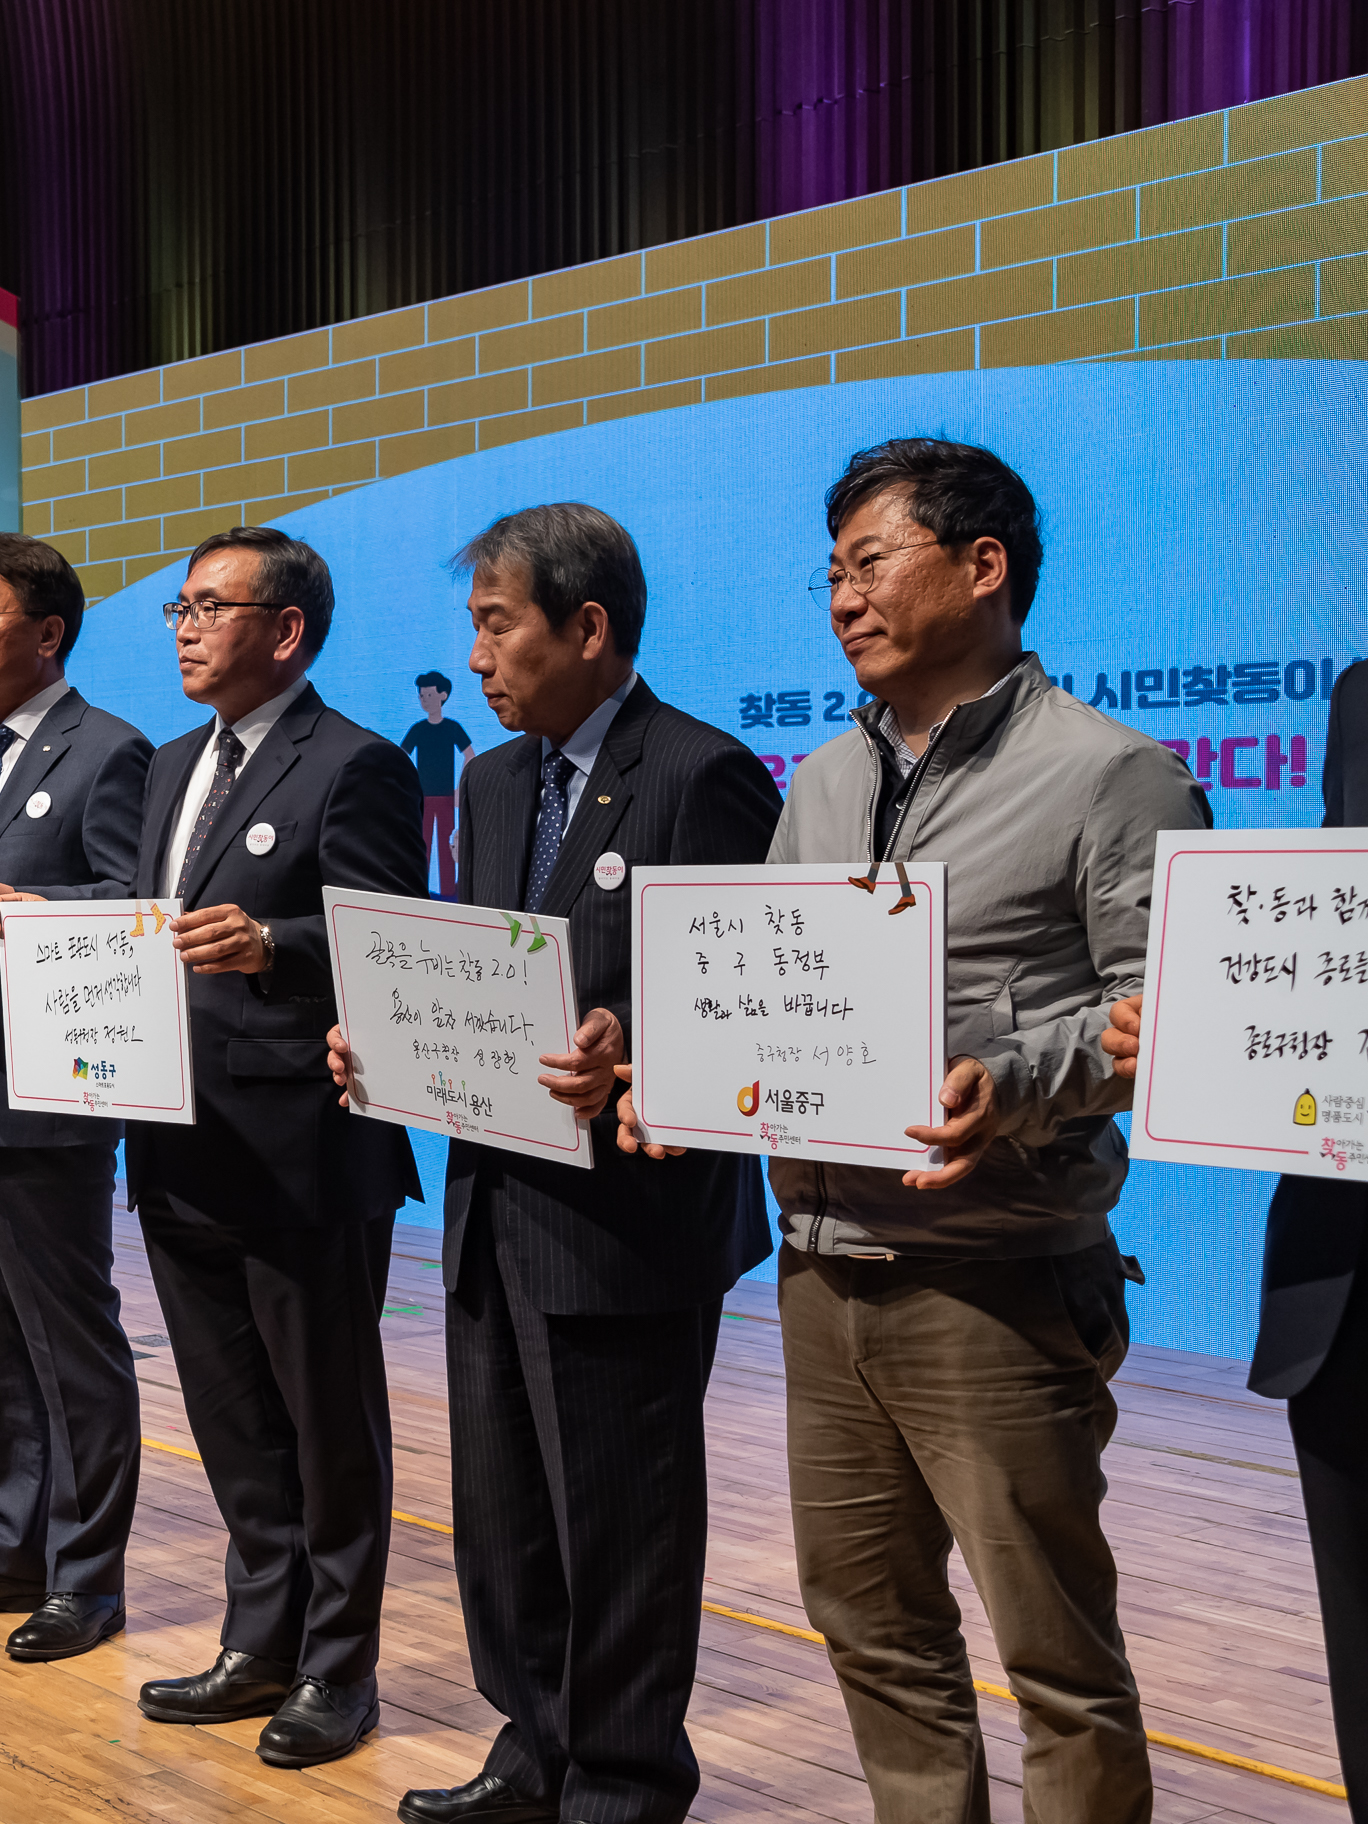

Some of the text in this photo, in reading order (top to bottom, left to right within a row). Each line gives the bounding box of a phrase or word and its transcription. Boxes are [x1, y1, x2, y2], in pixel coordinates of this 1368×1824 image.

[739, 691, 812, 729] 찾동
[1088, 658, 1333, 710] 시민찾동이
[596, 866, 624, 876] 시민찾동이
[688, 911, 744, 939] 서울시
[36, 942, 62, 963] 스마트
[68, 934, 99, 961] 포용도시
[365, 931, 413, 971] 골목을
[416, 939, 456, 978] 누비는
[459, 950, 483, 982] 찾동
[772, 947, 830, 981] 동정부
[1218, 950, 1298, 992] 건강도시
[46, 985, 81, 1015] 사람을
[738, 993, 770, 1017] 삶을
[783, 993, 854, 1021] 바꿉니다
[104, 1024, 143, 1044] 정원오
[1243, 1024, 1333, 1061] 종로구청장
[412, 1039, 460, 1063] 용산구청장
[755, 1042, 803, 1063] 중구청장
[91, 1060, 116, 1080] 성동구
[427, 1085, 493, 1117] 미래도시 용산
[765, 1088, 825, 1116] 서울중구
[1321, 1095, 1365, 1110] 사람중심
[760, 1121, 789, 1140] 찾아가는
[1321, 1109, 1364, 1126] 명품도시
